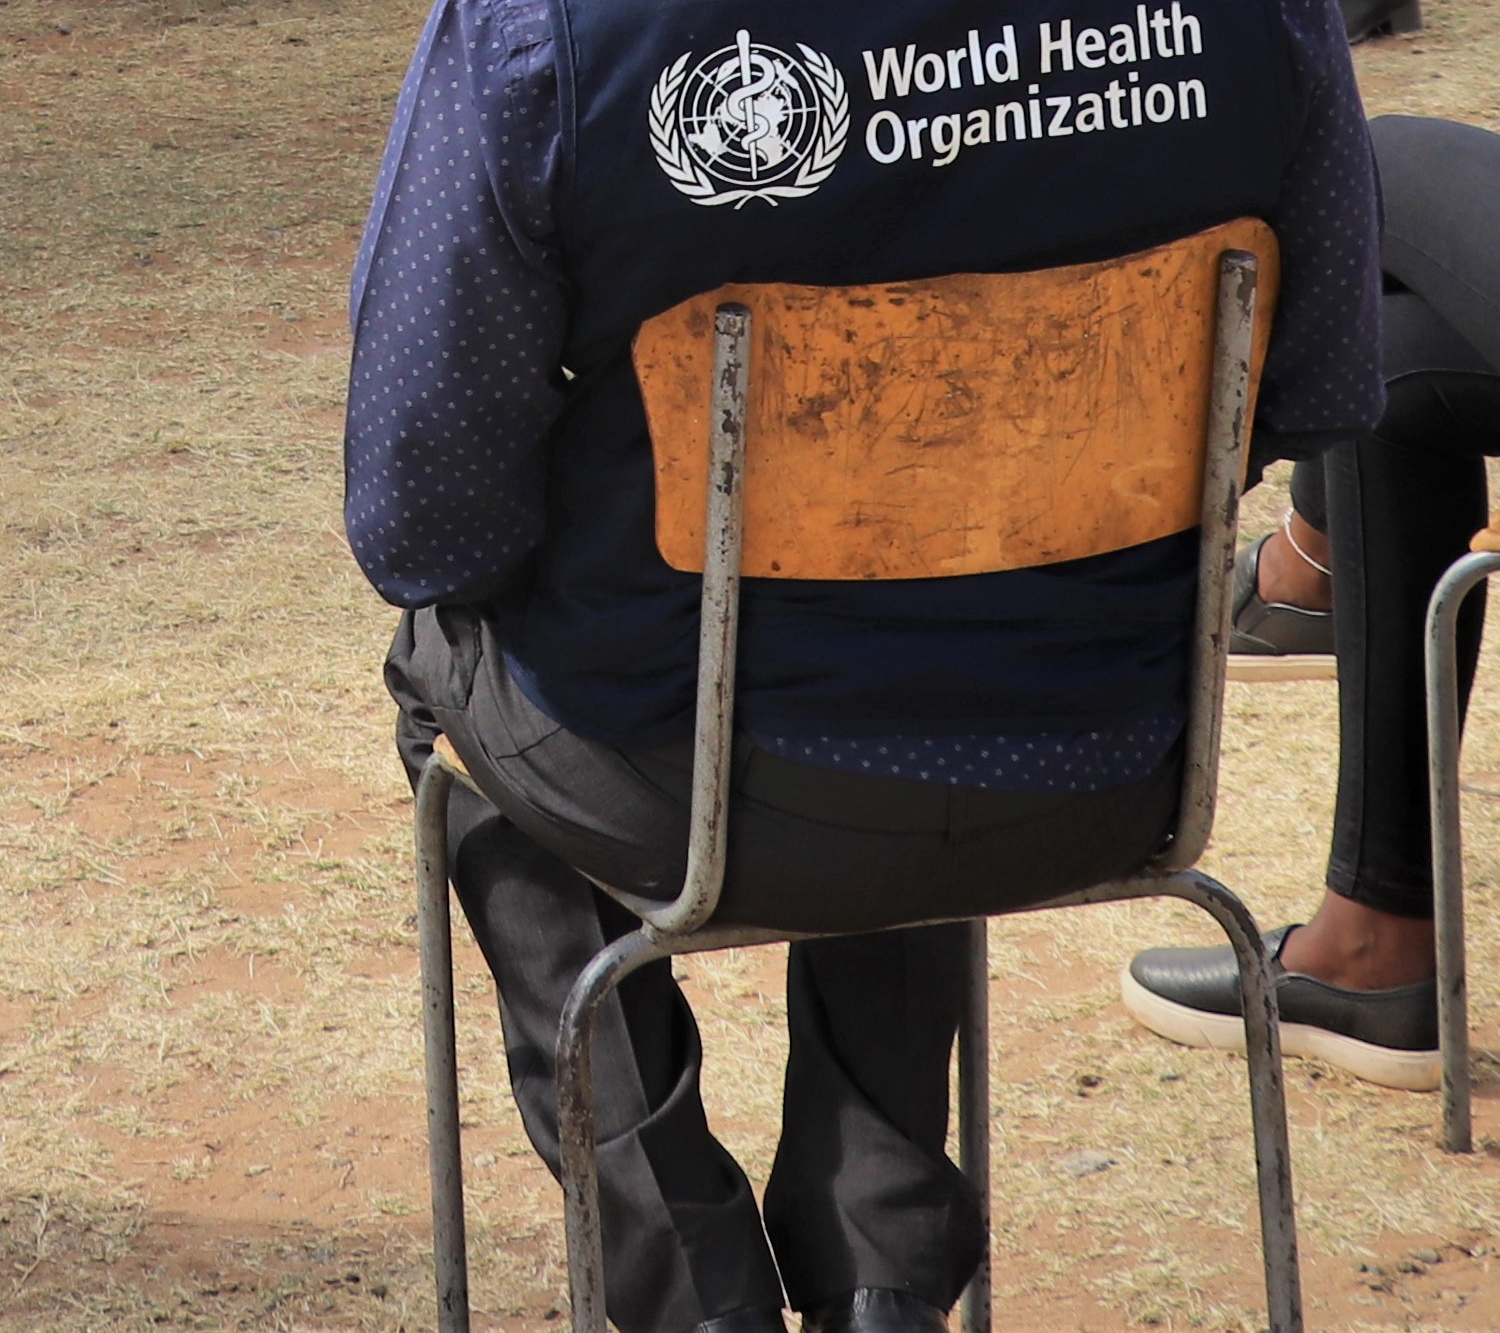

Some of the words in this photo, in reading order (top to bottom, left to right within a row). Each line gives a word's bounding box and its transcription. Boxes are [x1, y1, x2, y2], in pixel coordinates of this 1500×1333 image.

[863, 24, 1019, 101] World
[1039, 0, 1203, 74] Health
[865, 72, 1208, 167] Organization
